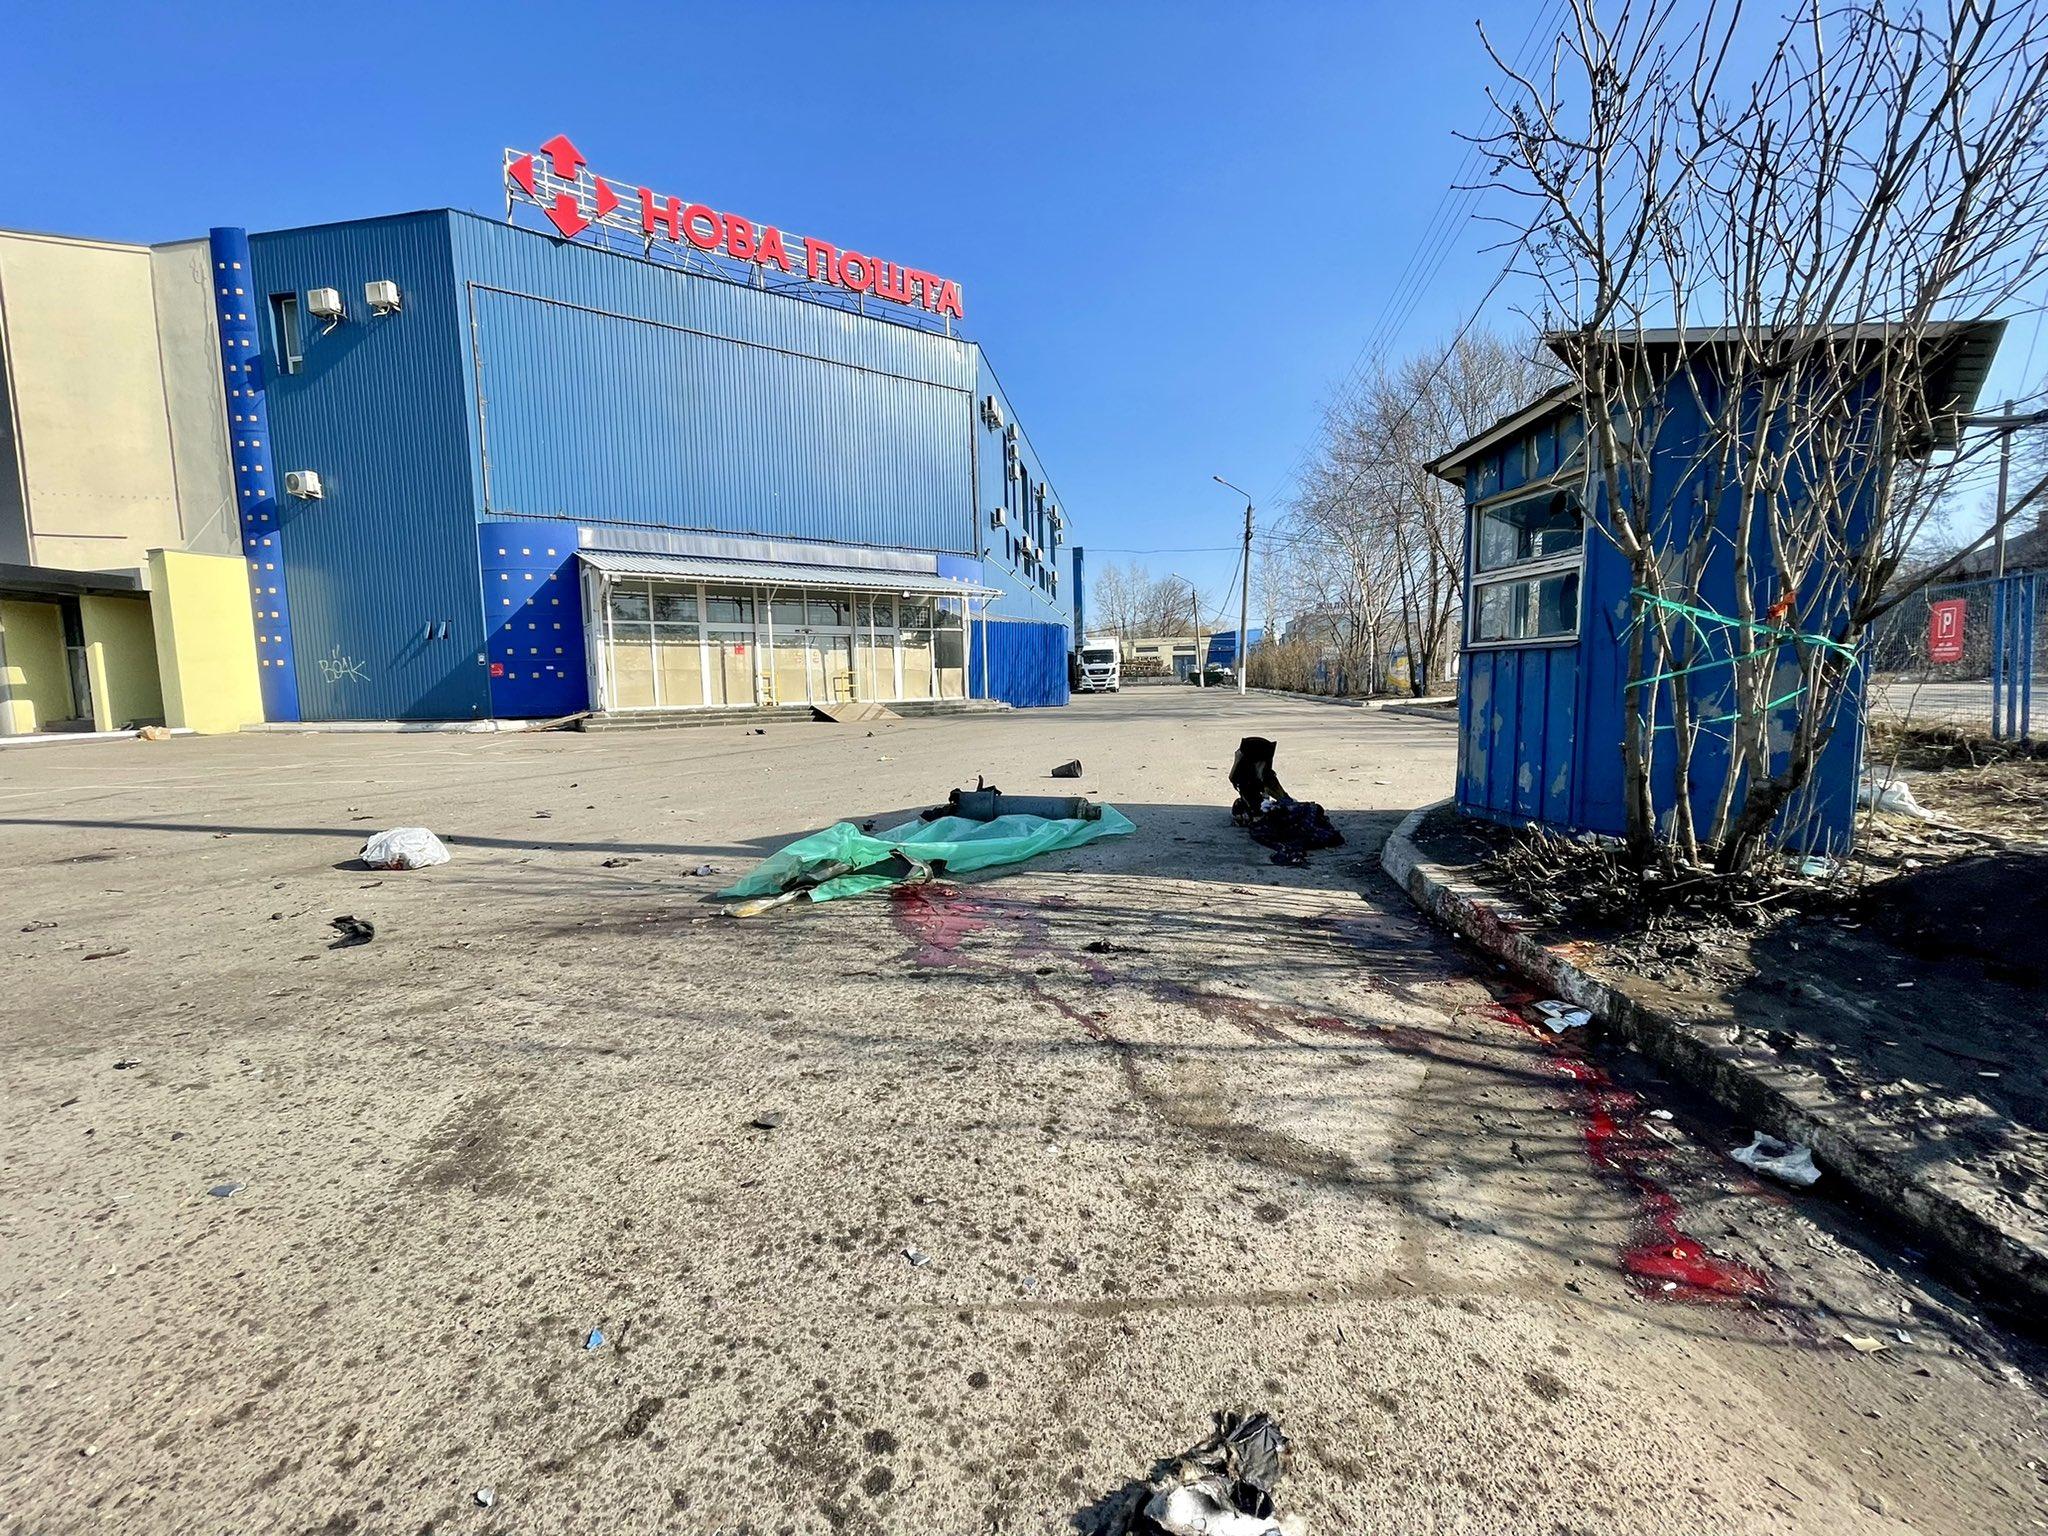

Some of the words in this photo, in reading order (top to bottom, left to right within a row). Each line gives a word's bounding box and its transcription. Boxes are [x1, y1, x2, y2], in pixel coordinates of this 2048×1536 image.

[637, 186, 792, 271] НОВА
[803, 236, 964, 319] ПОШТА
[1943, 612, 1952, 633] P
